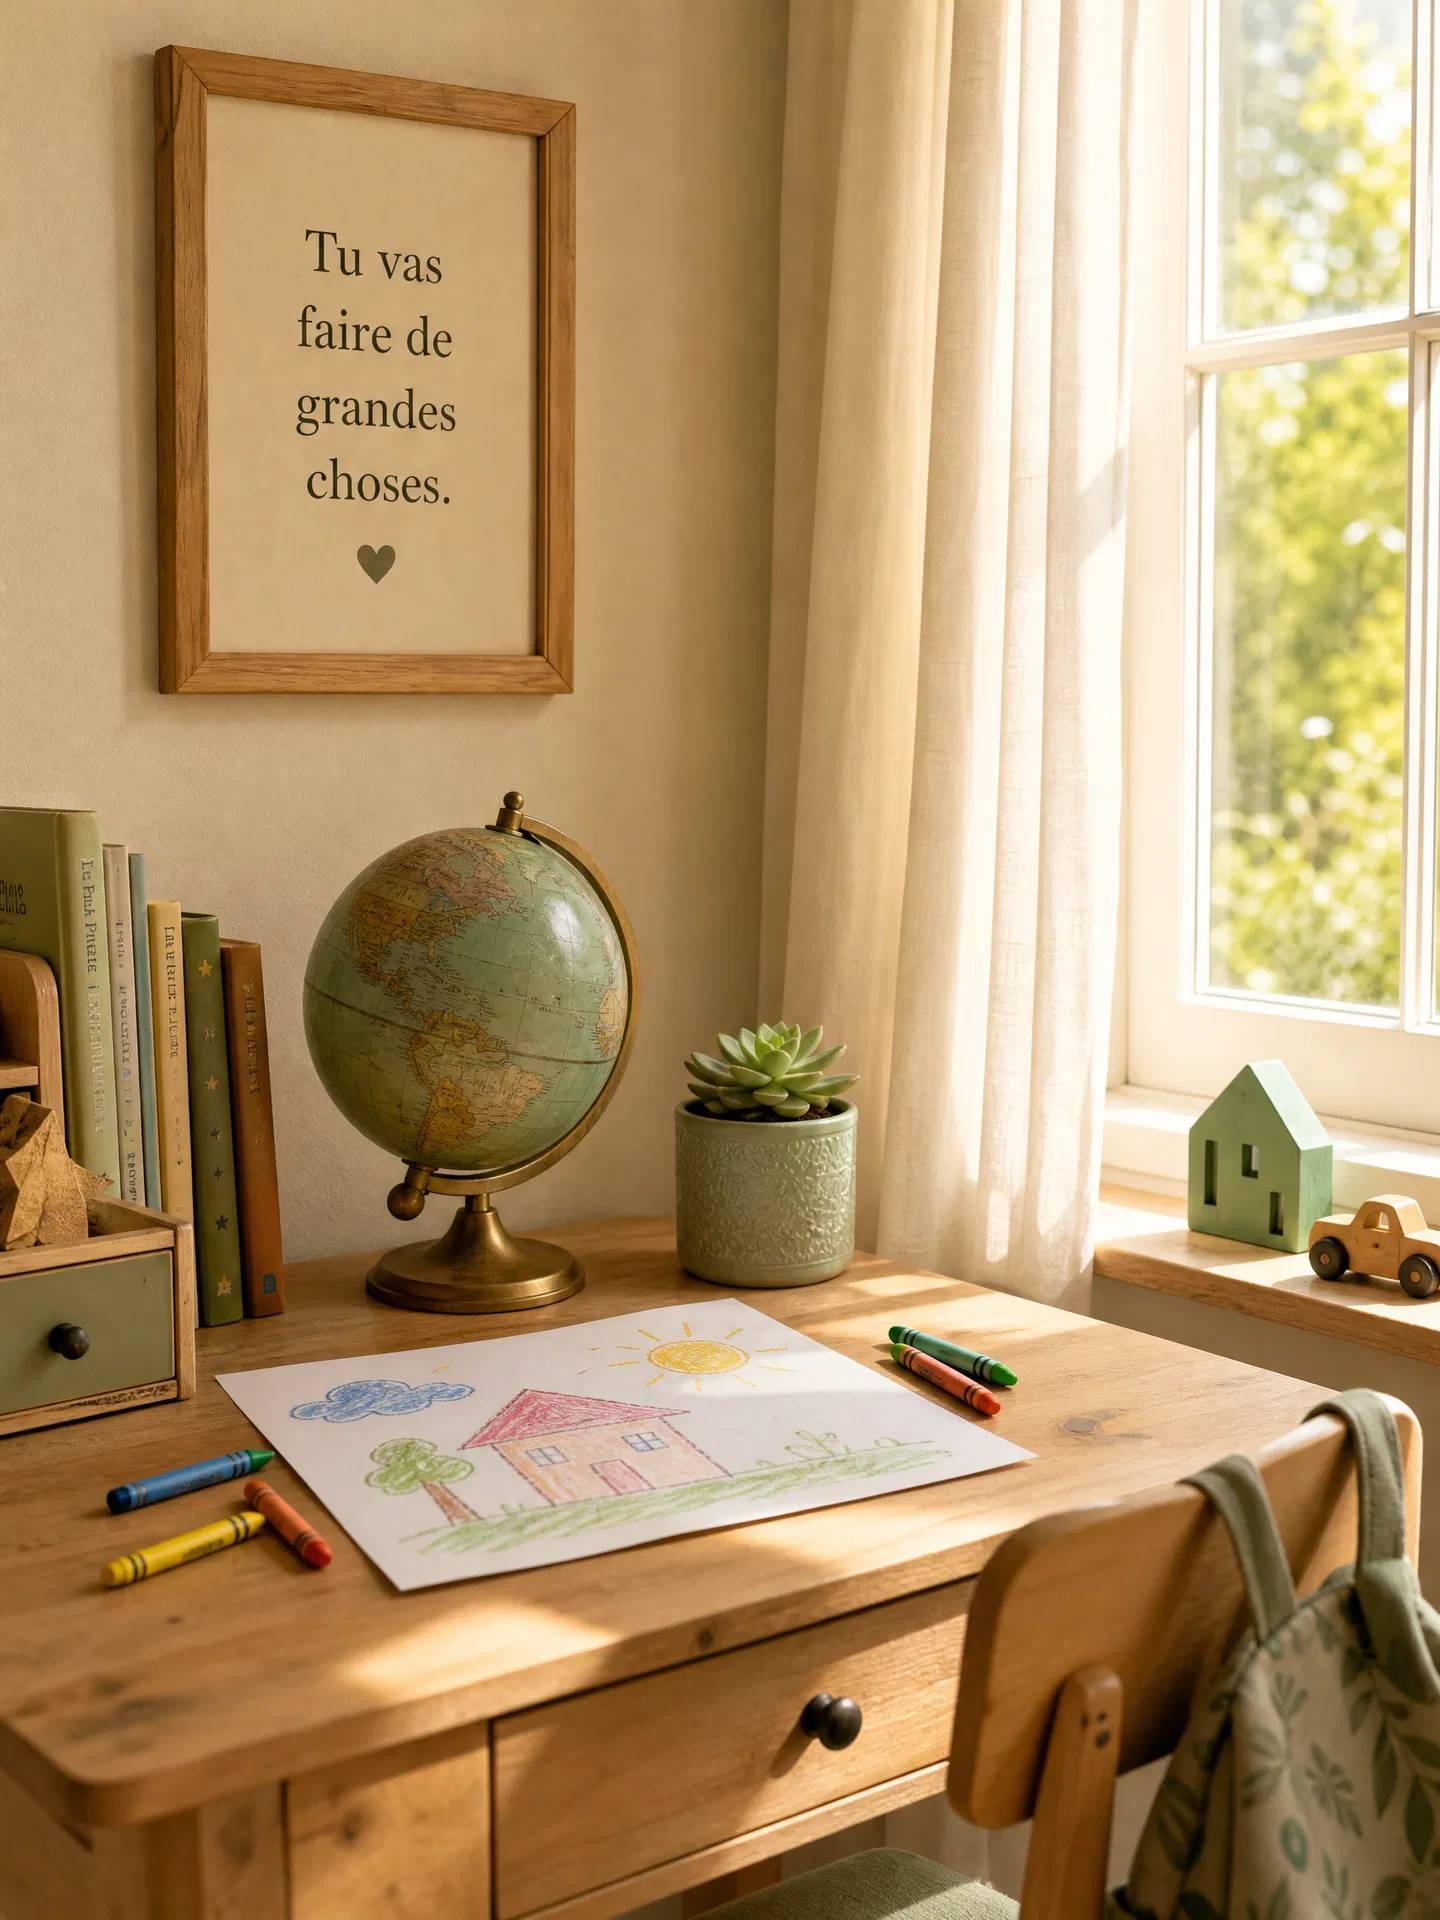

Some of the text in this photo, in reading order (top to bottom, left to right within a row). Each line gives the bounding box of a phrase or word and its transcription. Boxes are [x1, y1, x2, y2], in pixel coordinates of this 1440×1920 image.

[304, 228, 443, 285] Tu vas
[297, 304, 453, 359] faire de
[296, 387, 457, 437] grandes
[306, 457, 451, 505] choses.
